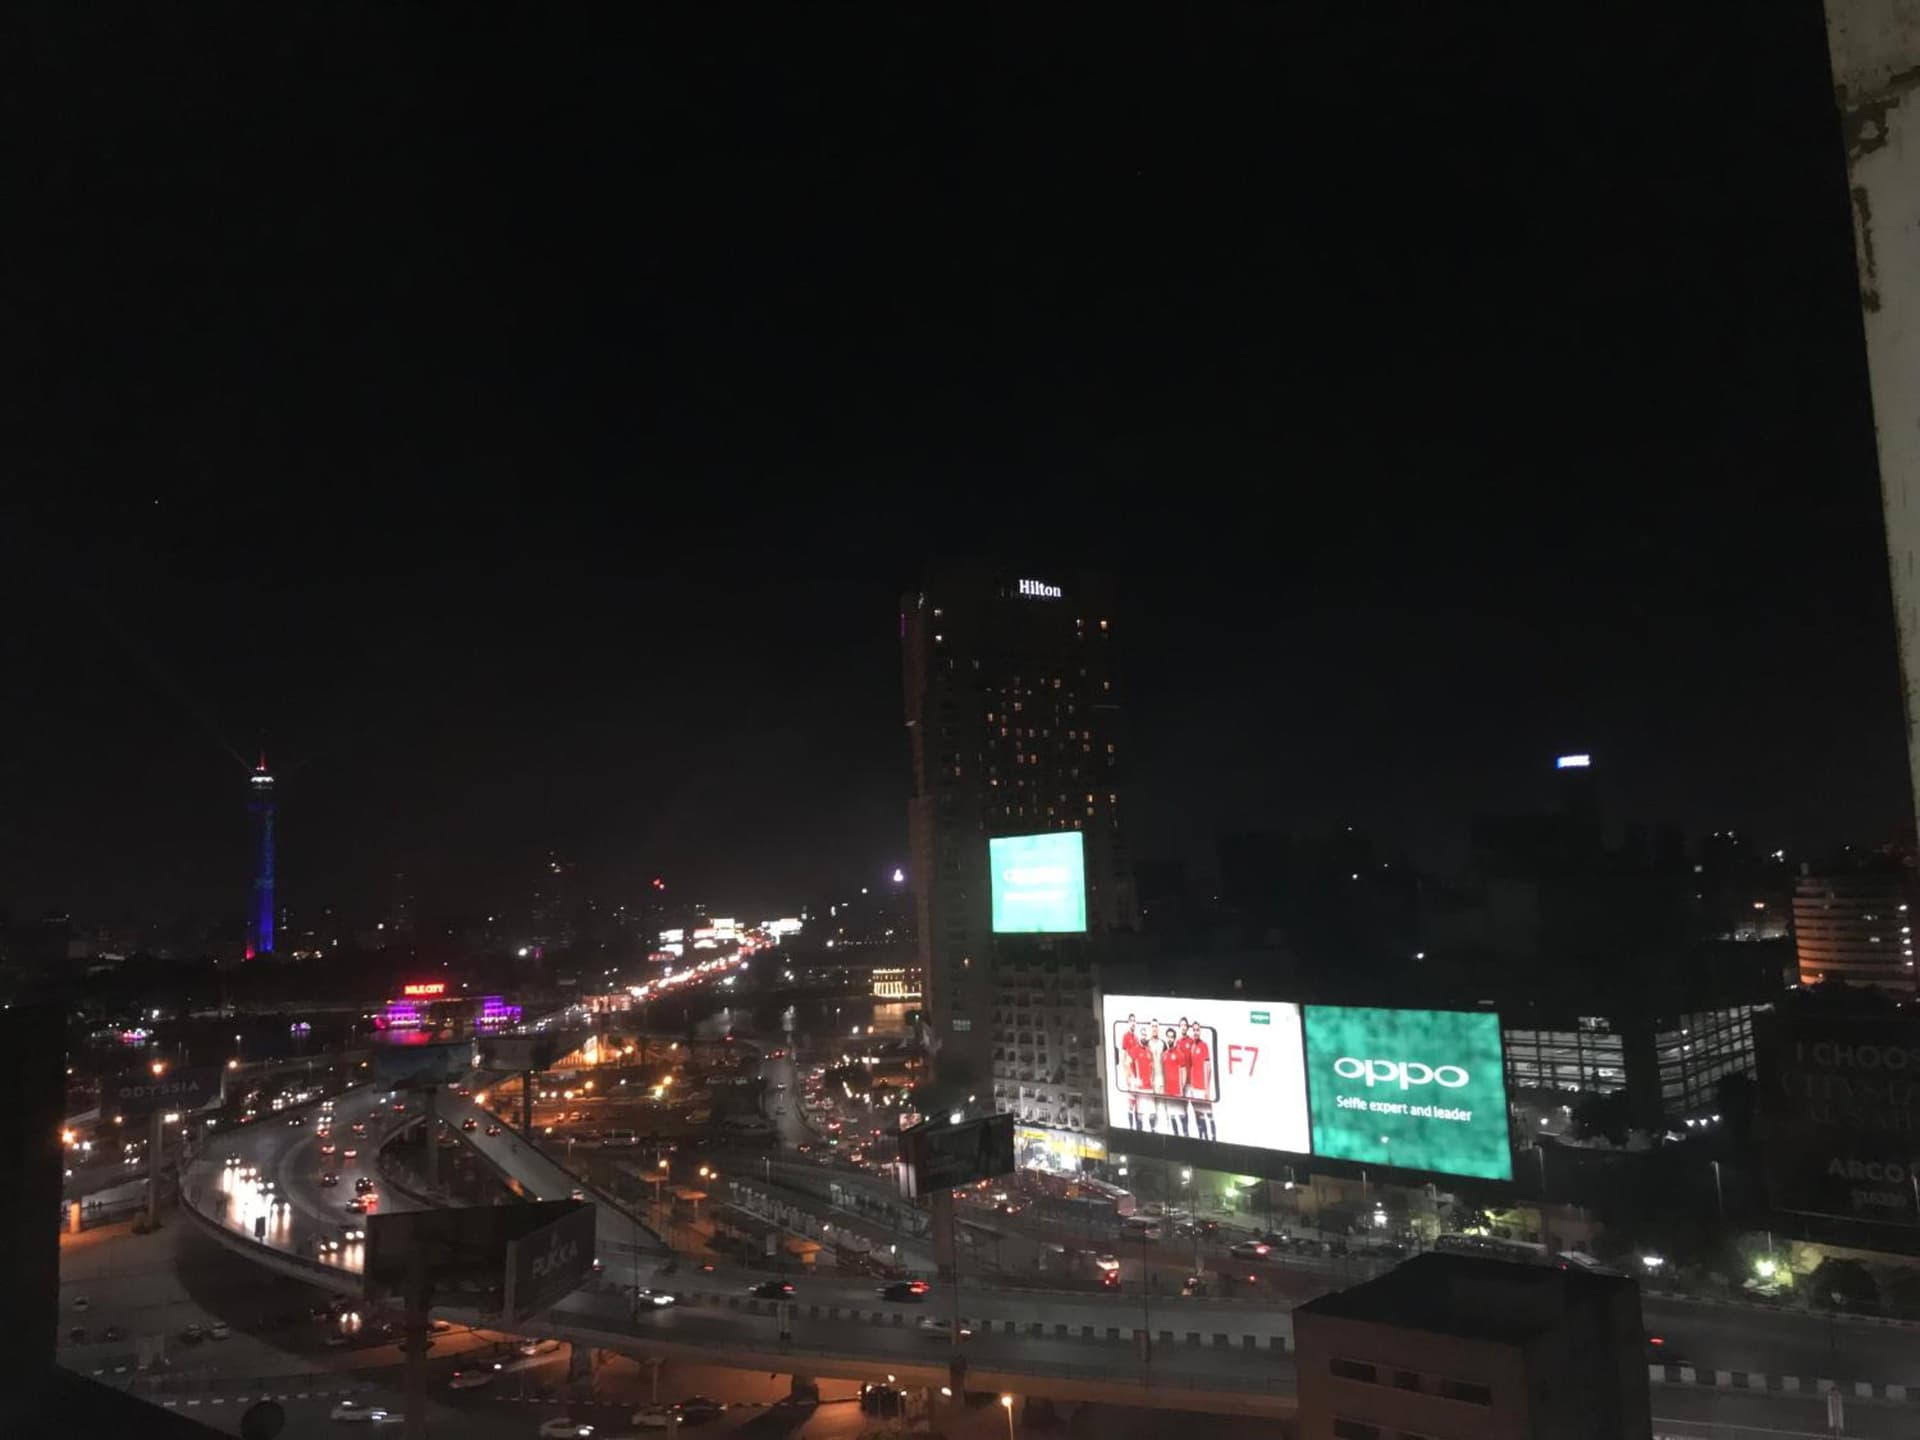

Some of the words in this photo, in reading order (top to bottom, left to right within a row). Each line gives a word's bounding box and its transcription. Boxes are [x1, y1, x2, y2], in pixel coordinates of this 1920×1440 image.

[1019, 579, 1061, 597] Hilton
[1228, 1044, 1259, 1077] F7
[1334, 1057, 1469, 1090] oppo
[1336, 1095, 1367, 1110] Selfie
[1369, 1100, 1408, 1114] expert
[1410, 1105, 1432, 1117] and
[1434, 1106, 1472, 1121] leader
